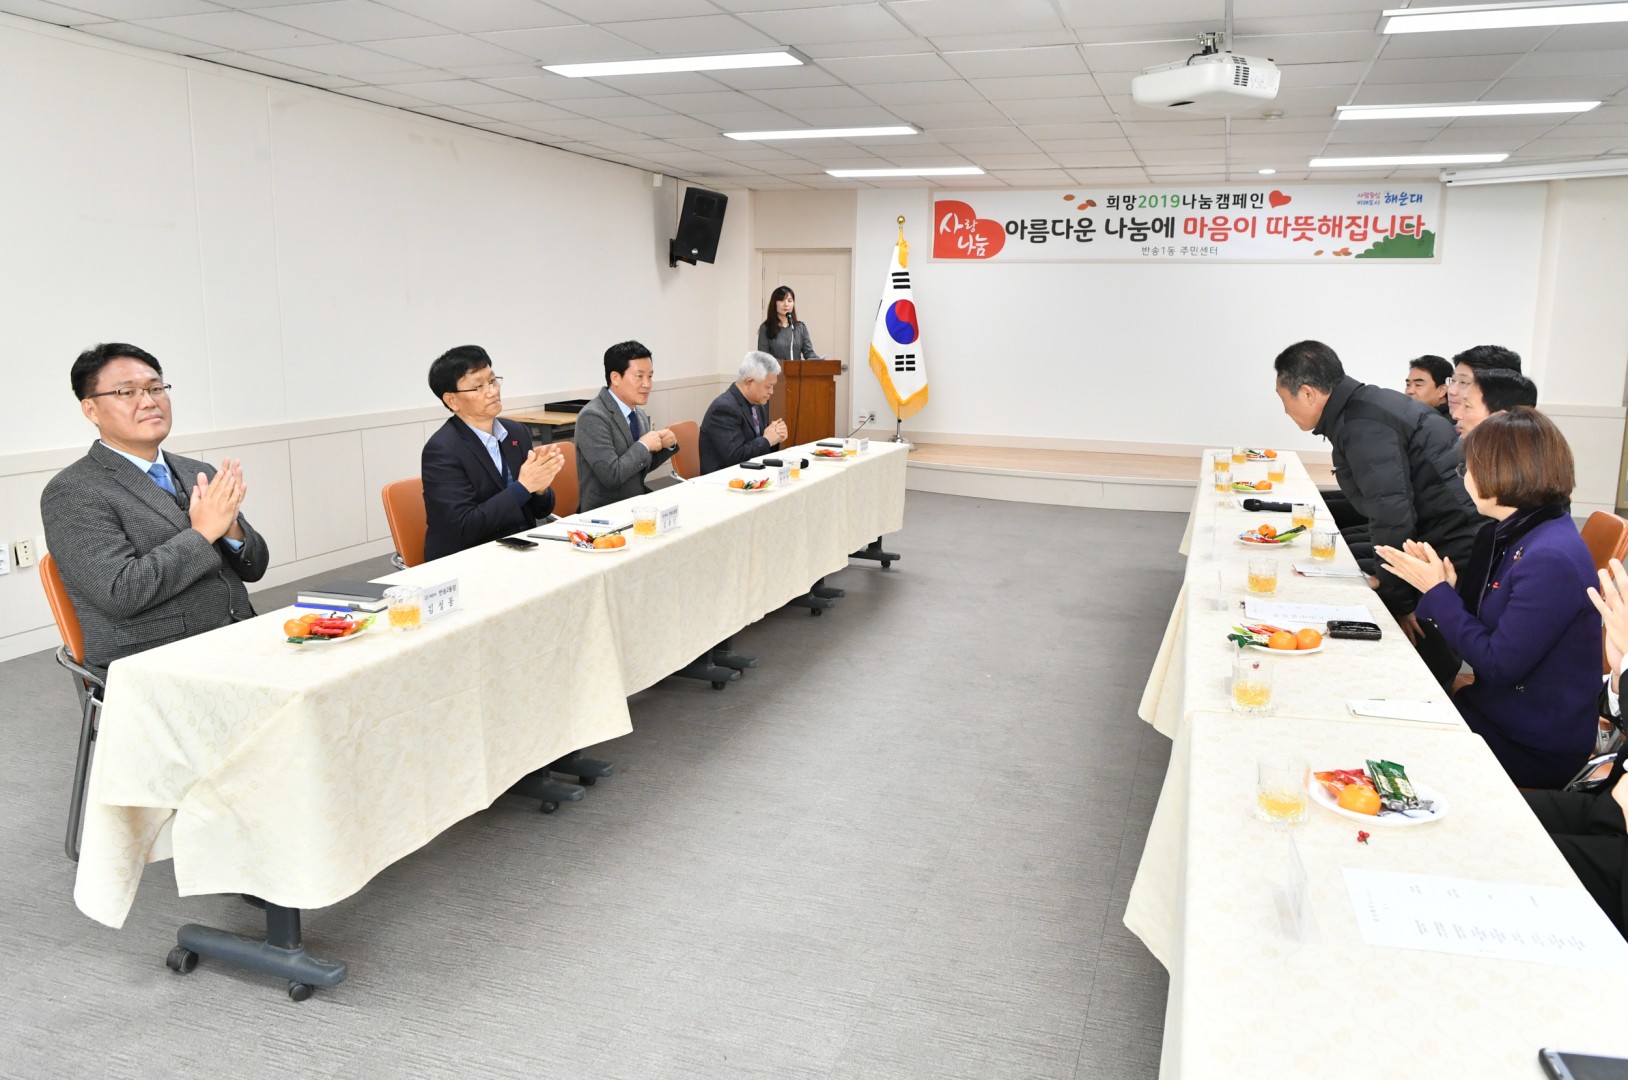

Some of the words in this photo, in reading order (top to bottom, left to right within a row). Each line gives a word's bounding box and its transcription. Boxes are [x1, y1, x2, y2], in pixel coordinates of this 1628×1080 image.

[1106, 193, 1264, 211] 희망2019나눔캠페인
[1384, 191, 1423, 206] 해운대
[939, 212, 979, 235] 사랑
[1005, 218, 1097, 244] 아름다운
[1104, 216, 1176, 242] 나눔에
[1183, 215, 1257, 242] 마음이
[1266, 214, 1426, 242] 따뜻해집니다
[957, 233, 990, 257] 나눔
[1141, 246, 1176, 257] 반송1동
[1180, 246, 1218, 257] 주민센터
